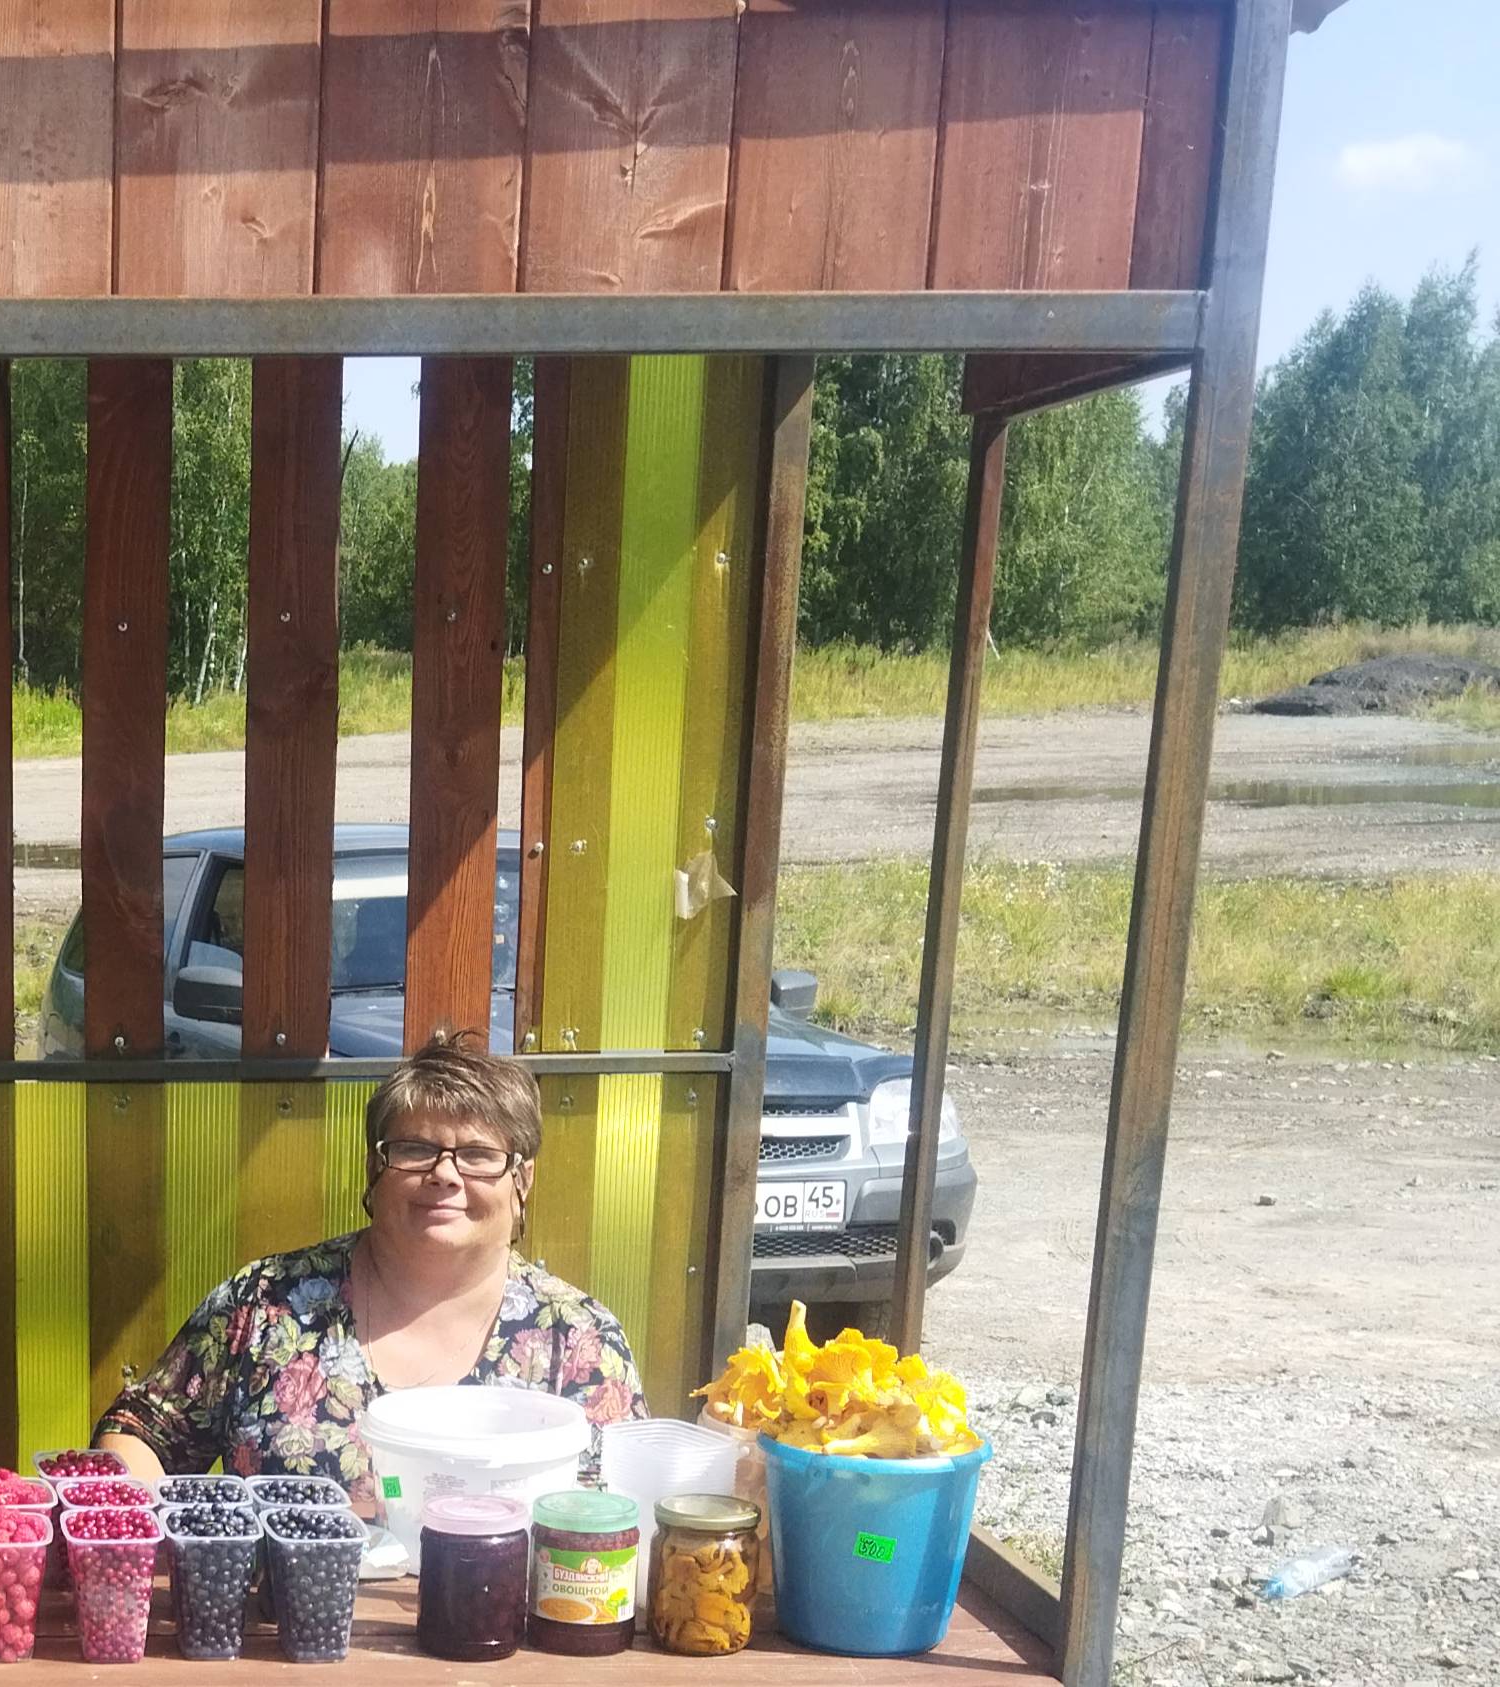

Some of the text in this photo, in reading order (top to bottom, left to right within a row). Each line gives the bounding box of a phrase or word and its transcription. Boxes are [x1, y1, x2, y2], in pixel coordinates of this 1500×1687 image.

[755, 1195, 798, 1218] ОВ
[807, 1186, 834, 1209] 45
[804, 1209, 826, 1219] RUS
